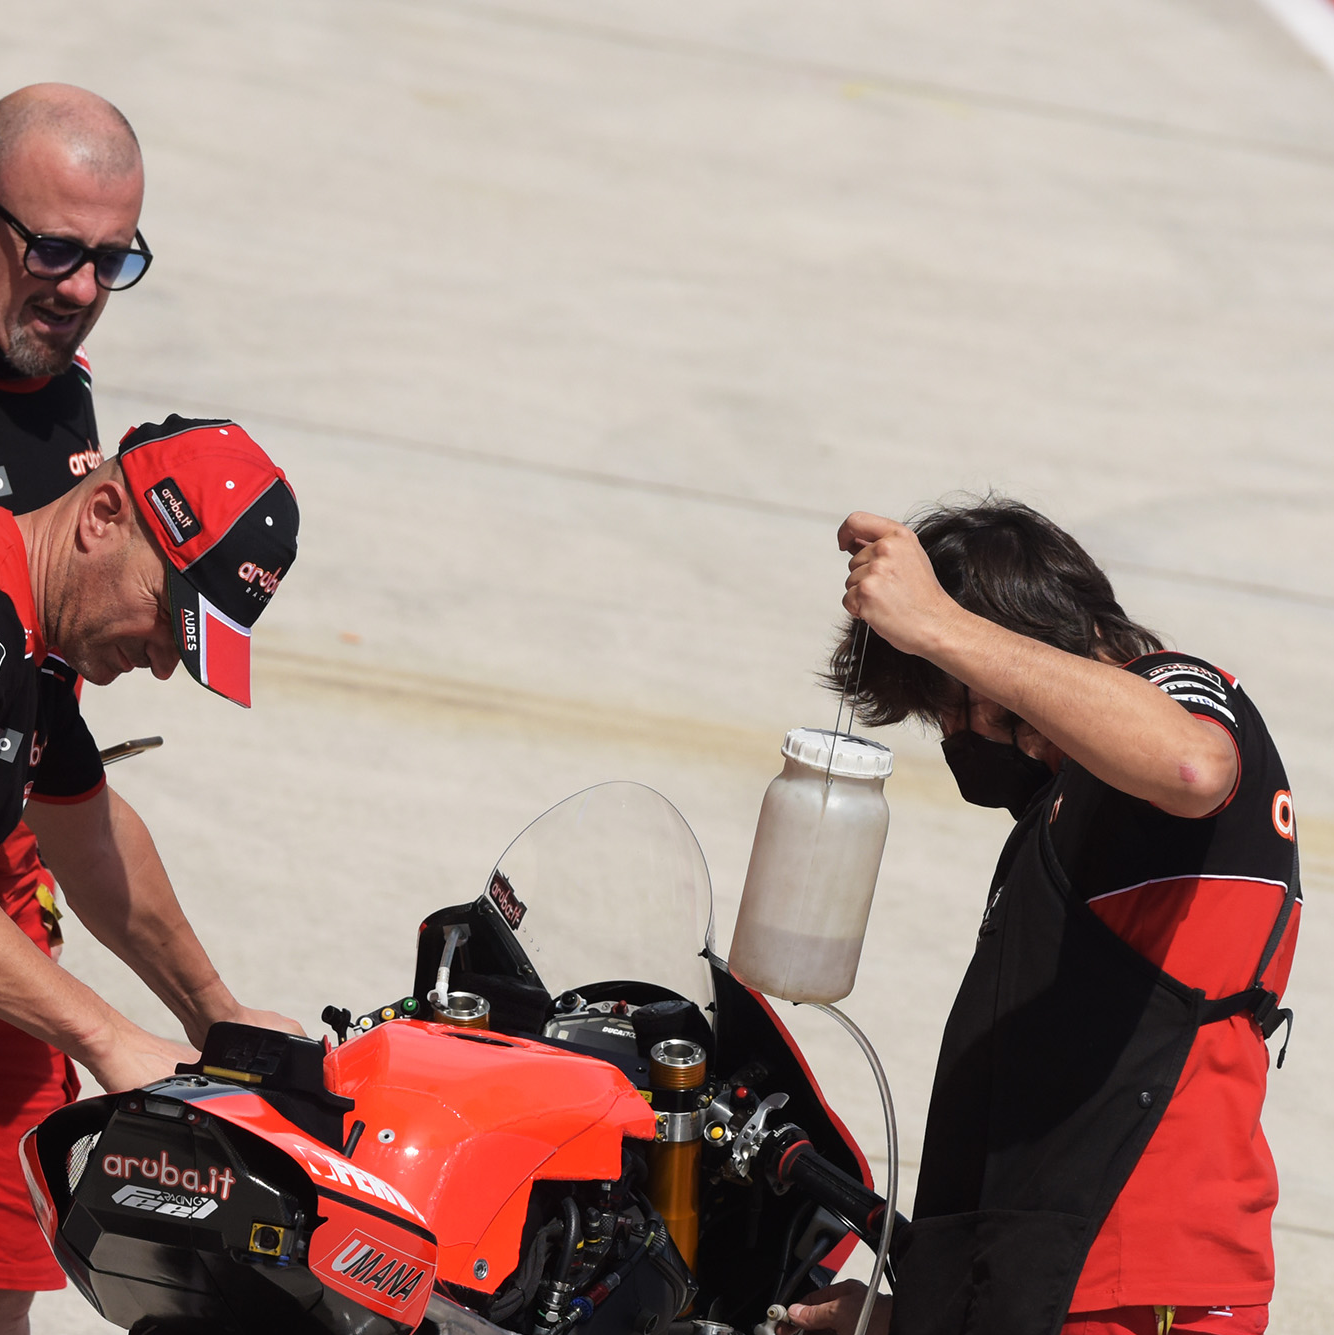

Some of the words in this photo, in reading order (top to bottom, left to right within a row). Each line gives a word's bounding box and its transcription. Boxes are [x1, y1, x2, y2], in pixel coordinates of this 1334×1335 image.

[161, 487, 192, 529] aruba.it
[183, 608, 197, 651] AUDES
[102, 1150, 237, 1200] aruba.it
[331, 1238, 427, 1303] UMANA
